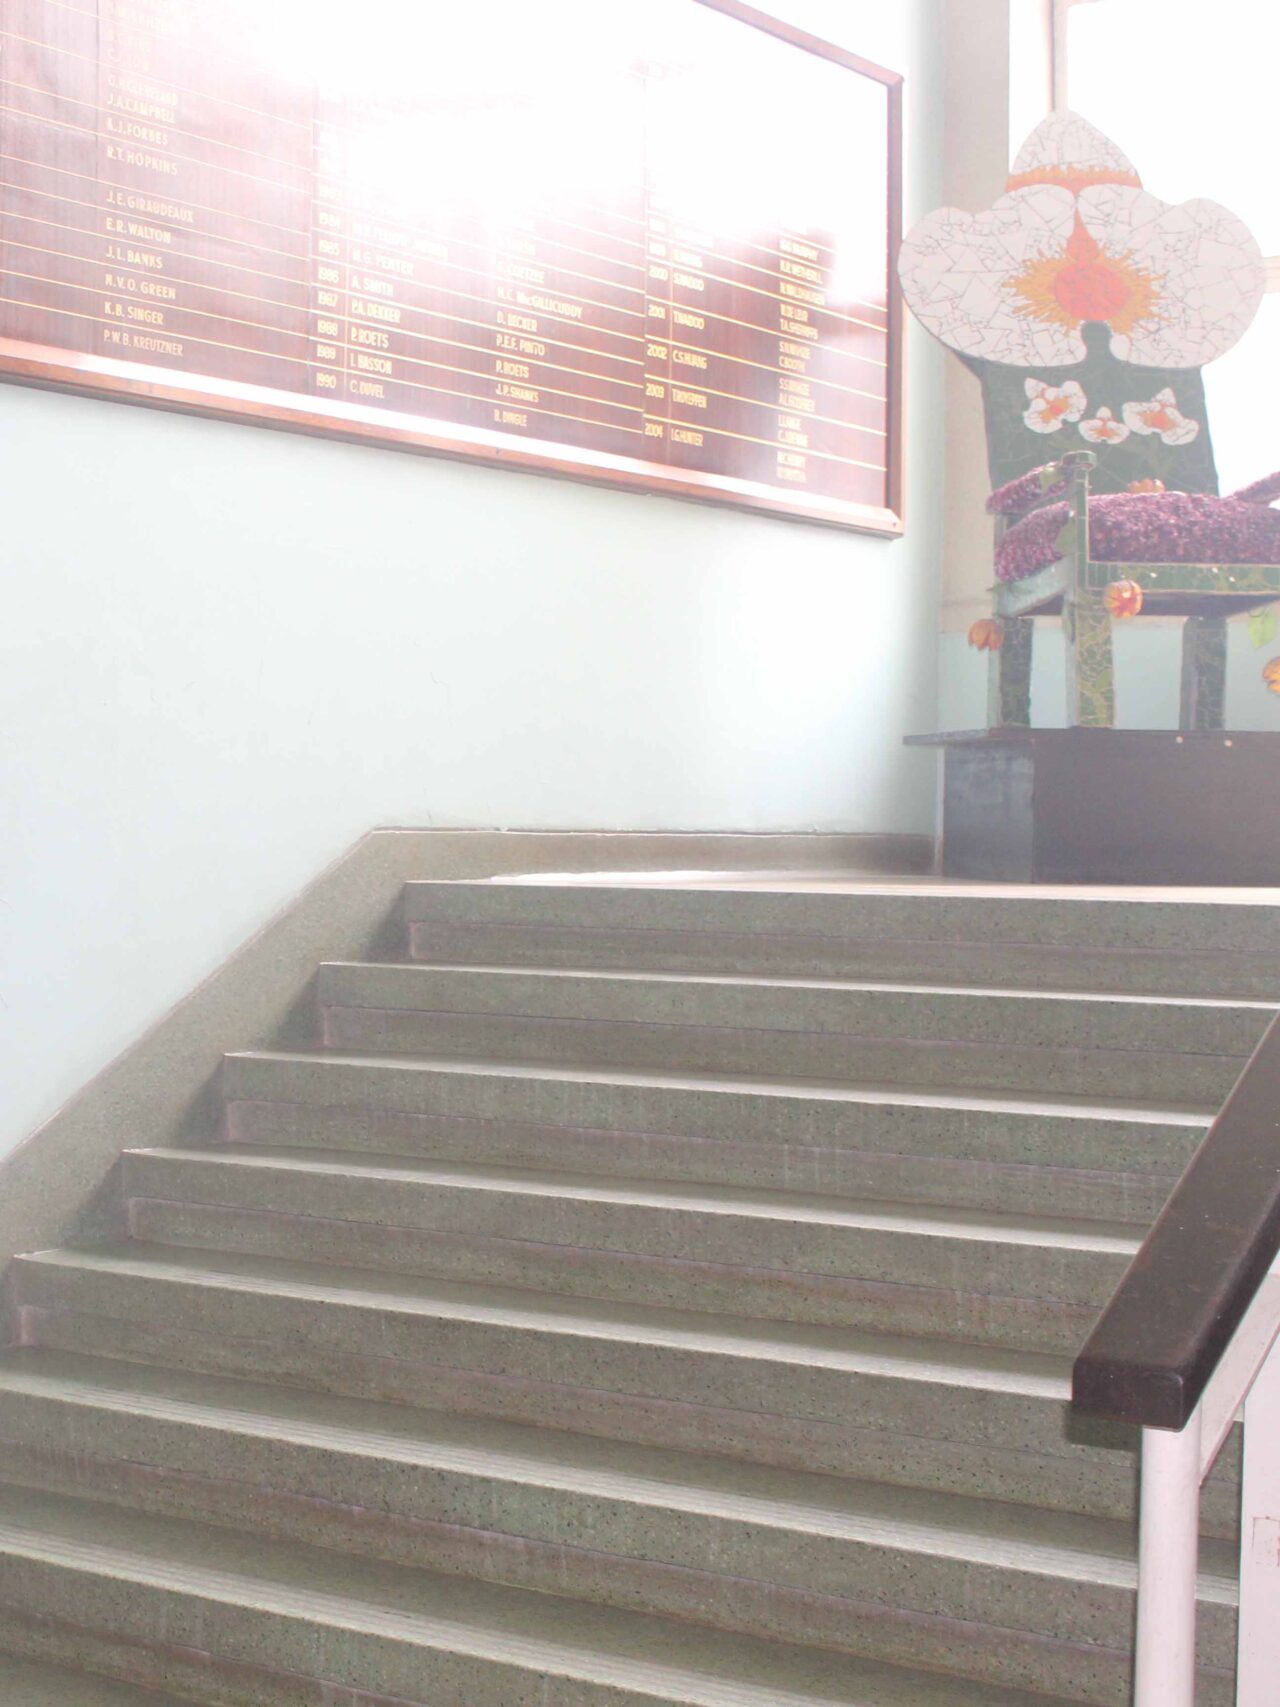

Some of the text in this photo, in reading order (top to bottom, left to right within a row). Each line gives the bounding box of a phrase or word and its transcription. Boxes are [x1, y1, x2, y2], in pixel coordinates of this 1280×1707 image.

[128, 221, 172, 244] WALTON
[127, 250, 163, 270] BANKS
[140, 281, 177, 300] GREEN
[317, 290, 340, 308] 1987
[127, 305, 164, 326] SINGER
[317, 319, 339, 337] 1988
[316, 344, 337, 361] 1989
[646, 343, 668, 360] 2002
[316, 372, 337, 389] 1990
[645, 382, 665, 399] 2003
[644, 422, 664, 438] 2004
